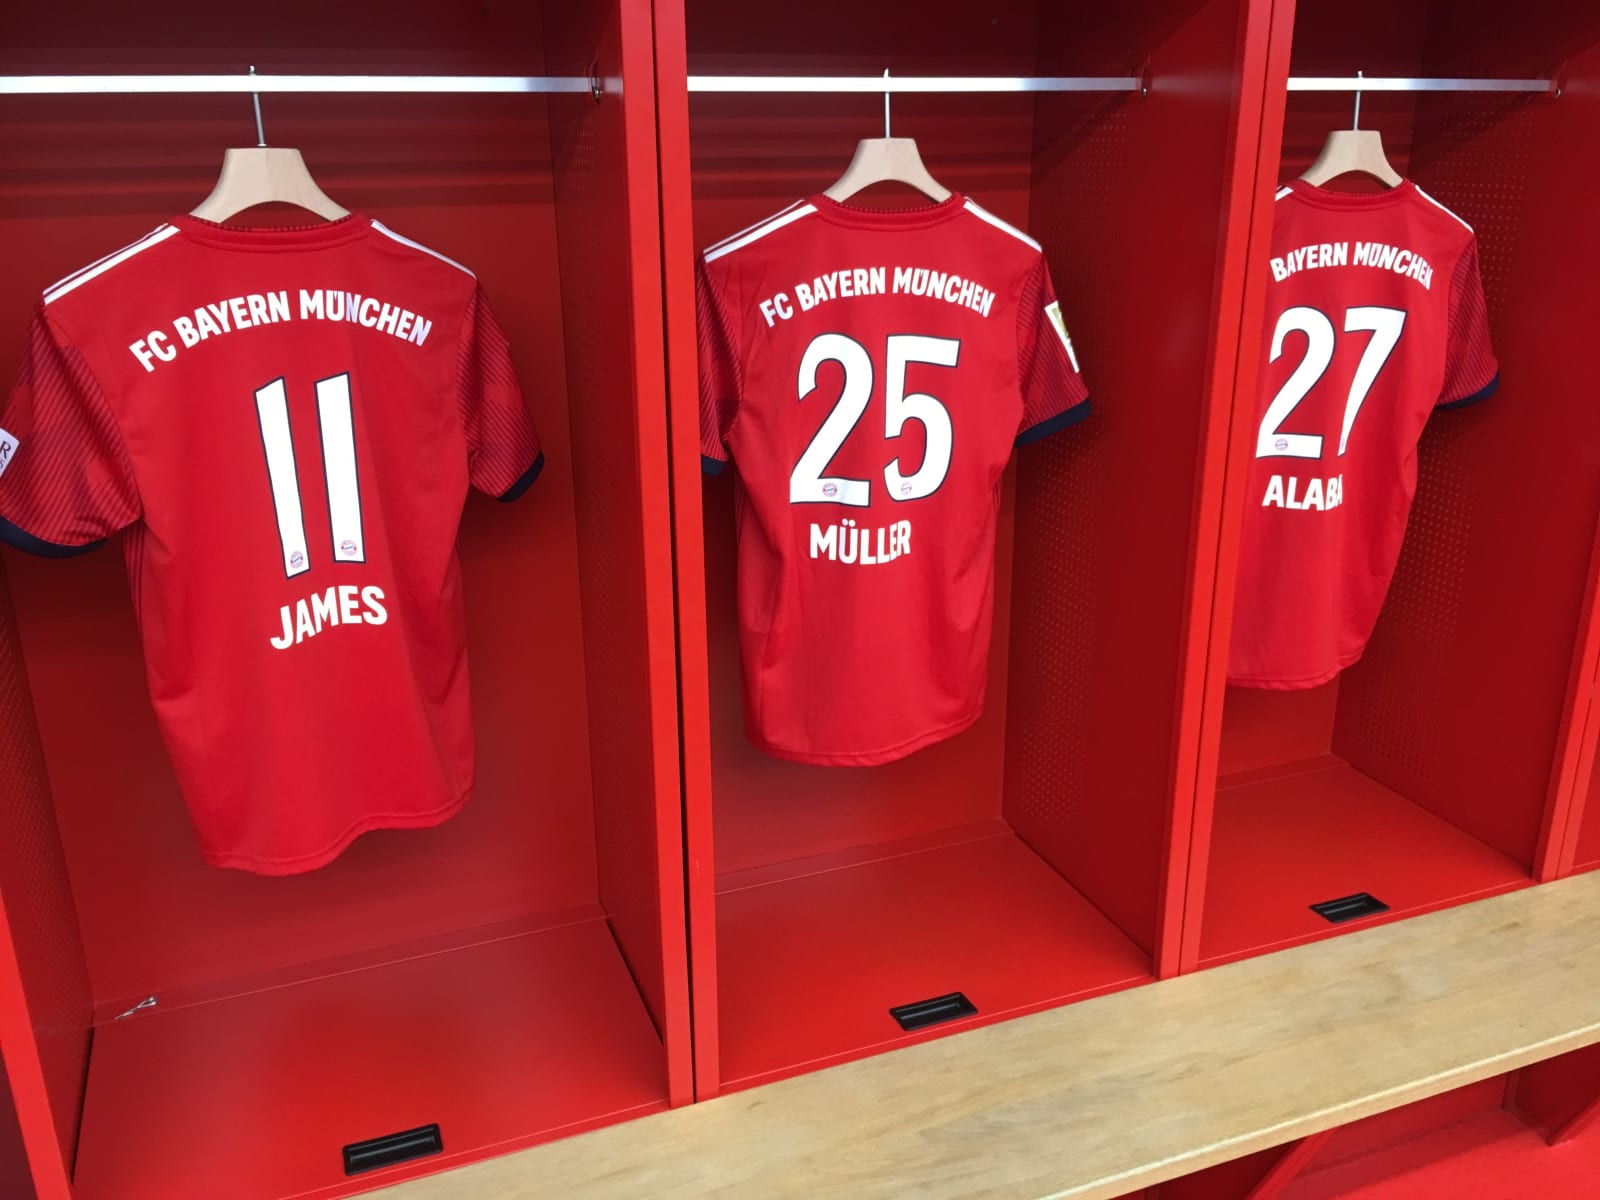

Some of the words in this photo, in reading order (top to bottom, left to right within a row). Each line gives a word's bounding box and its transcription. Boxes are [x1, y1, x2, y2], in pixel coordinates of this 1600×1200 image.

[759, 292, 794, 328] FC
[794, 266, 886, 312] BAYERN
[892, 266, 996, 318] MÜNCHEN
[1269, 241, 1348, 283] BAYERN
[1352, 241, 1434, 291] MÜNCHEN
[128, 330, 177, 373] FC
[172, 290, 291, 349] BAYERN
[299, 289, 433, 347] MÜNCHEN
[1255, 305, 1408, 460] 27
[789, 332, 961, 507] 25
[253, 371, 366, 580] 11
[1261, 473, 1343, 511] ALABA
[809, 518, 912, 566] MÜLLER
[269, 585, 389, 651] JAMES
